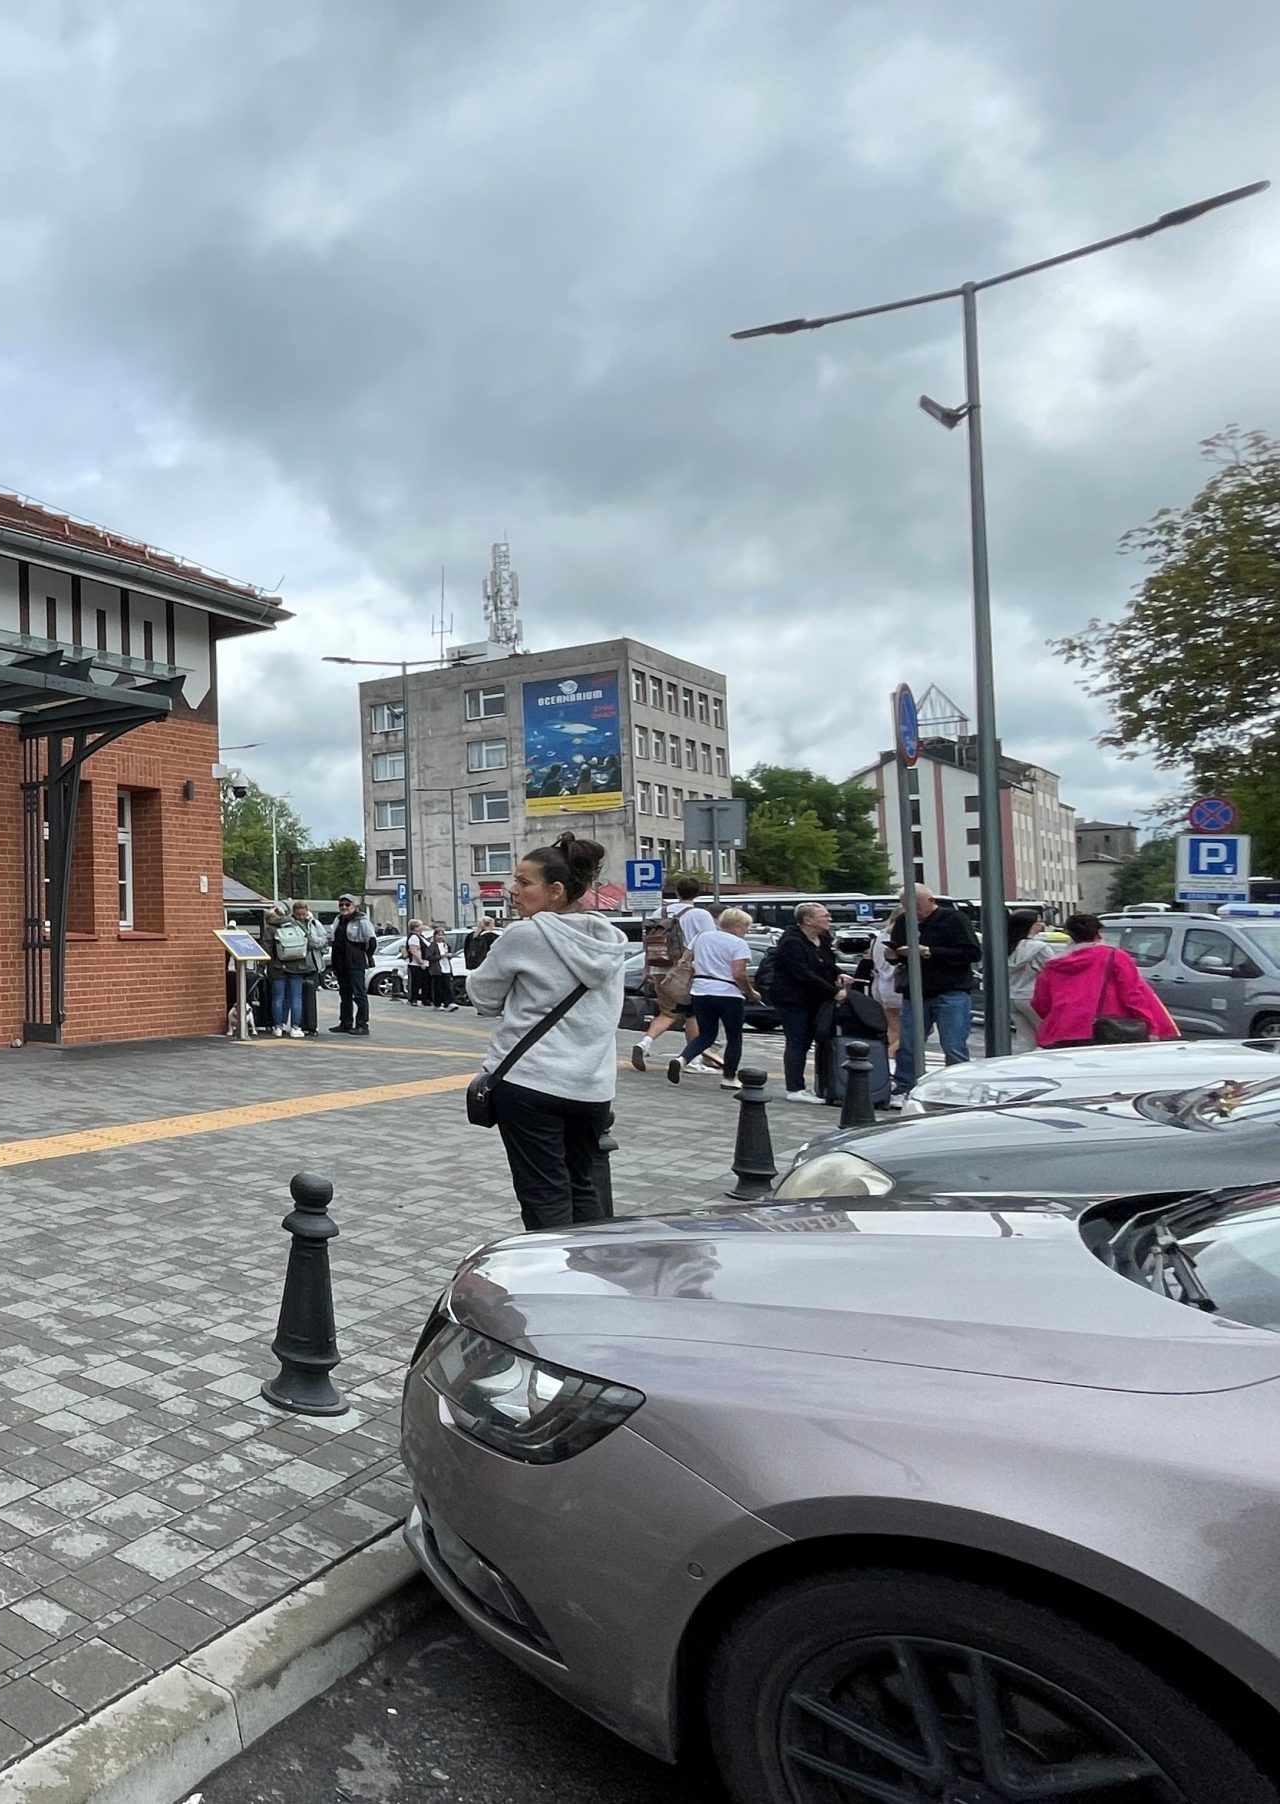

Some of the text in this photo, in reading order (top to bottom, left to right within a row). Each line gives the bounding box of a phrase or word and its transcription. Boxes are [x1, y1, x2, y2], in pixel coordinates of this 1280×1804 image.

[538, 690, 602, 706] OCEANARIUM
[1199, 842, 1227, 871] P
[634, 863, 655, 888] P
[399, 885, 406, 898] P
[859, 904, 869, 915] P
